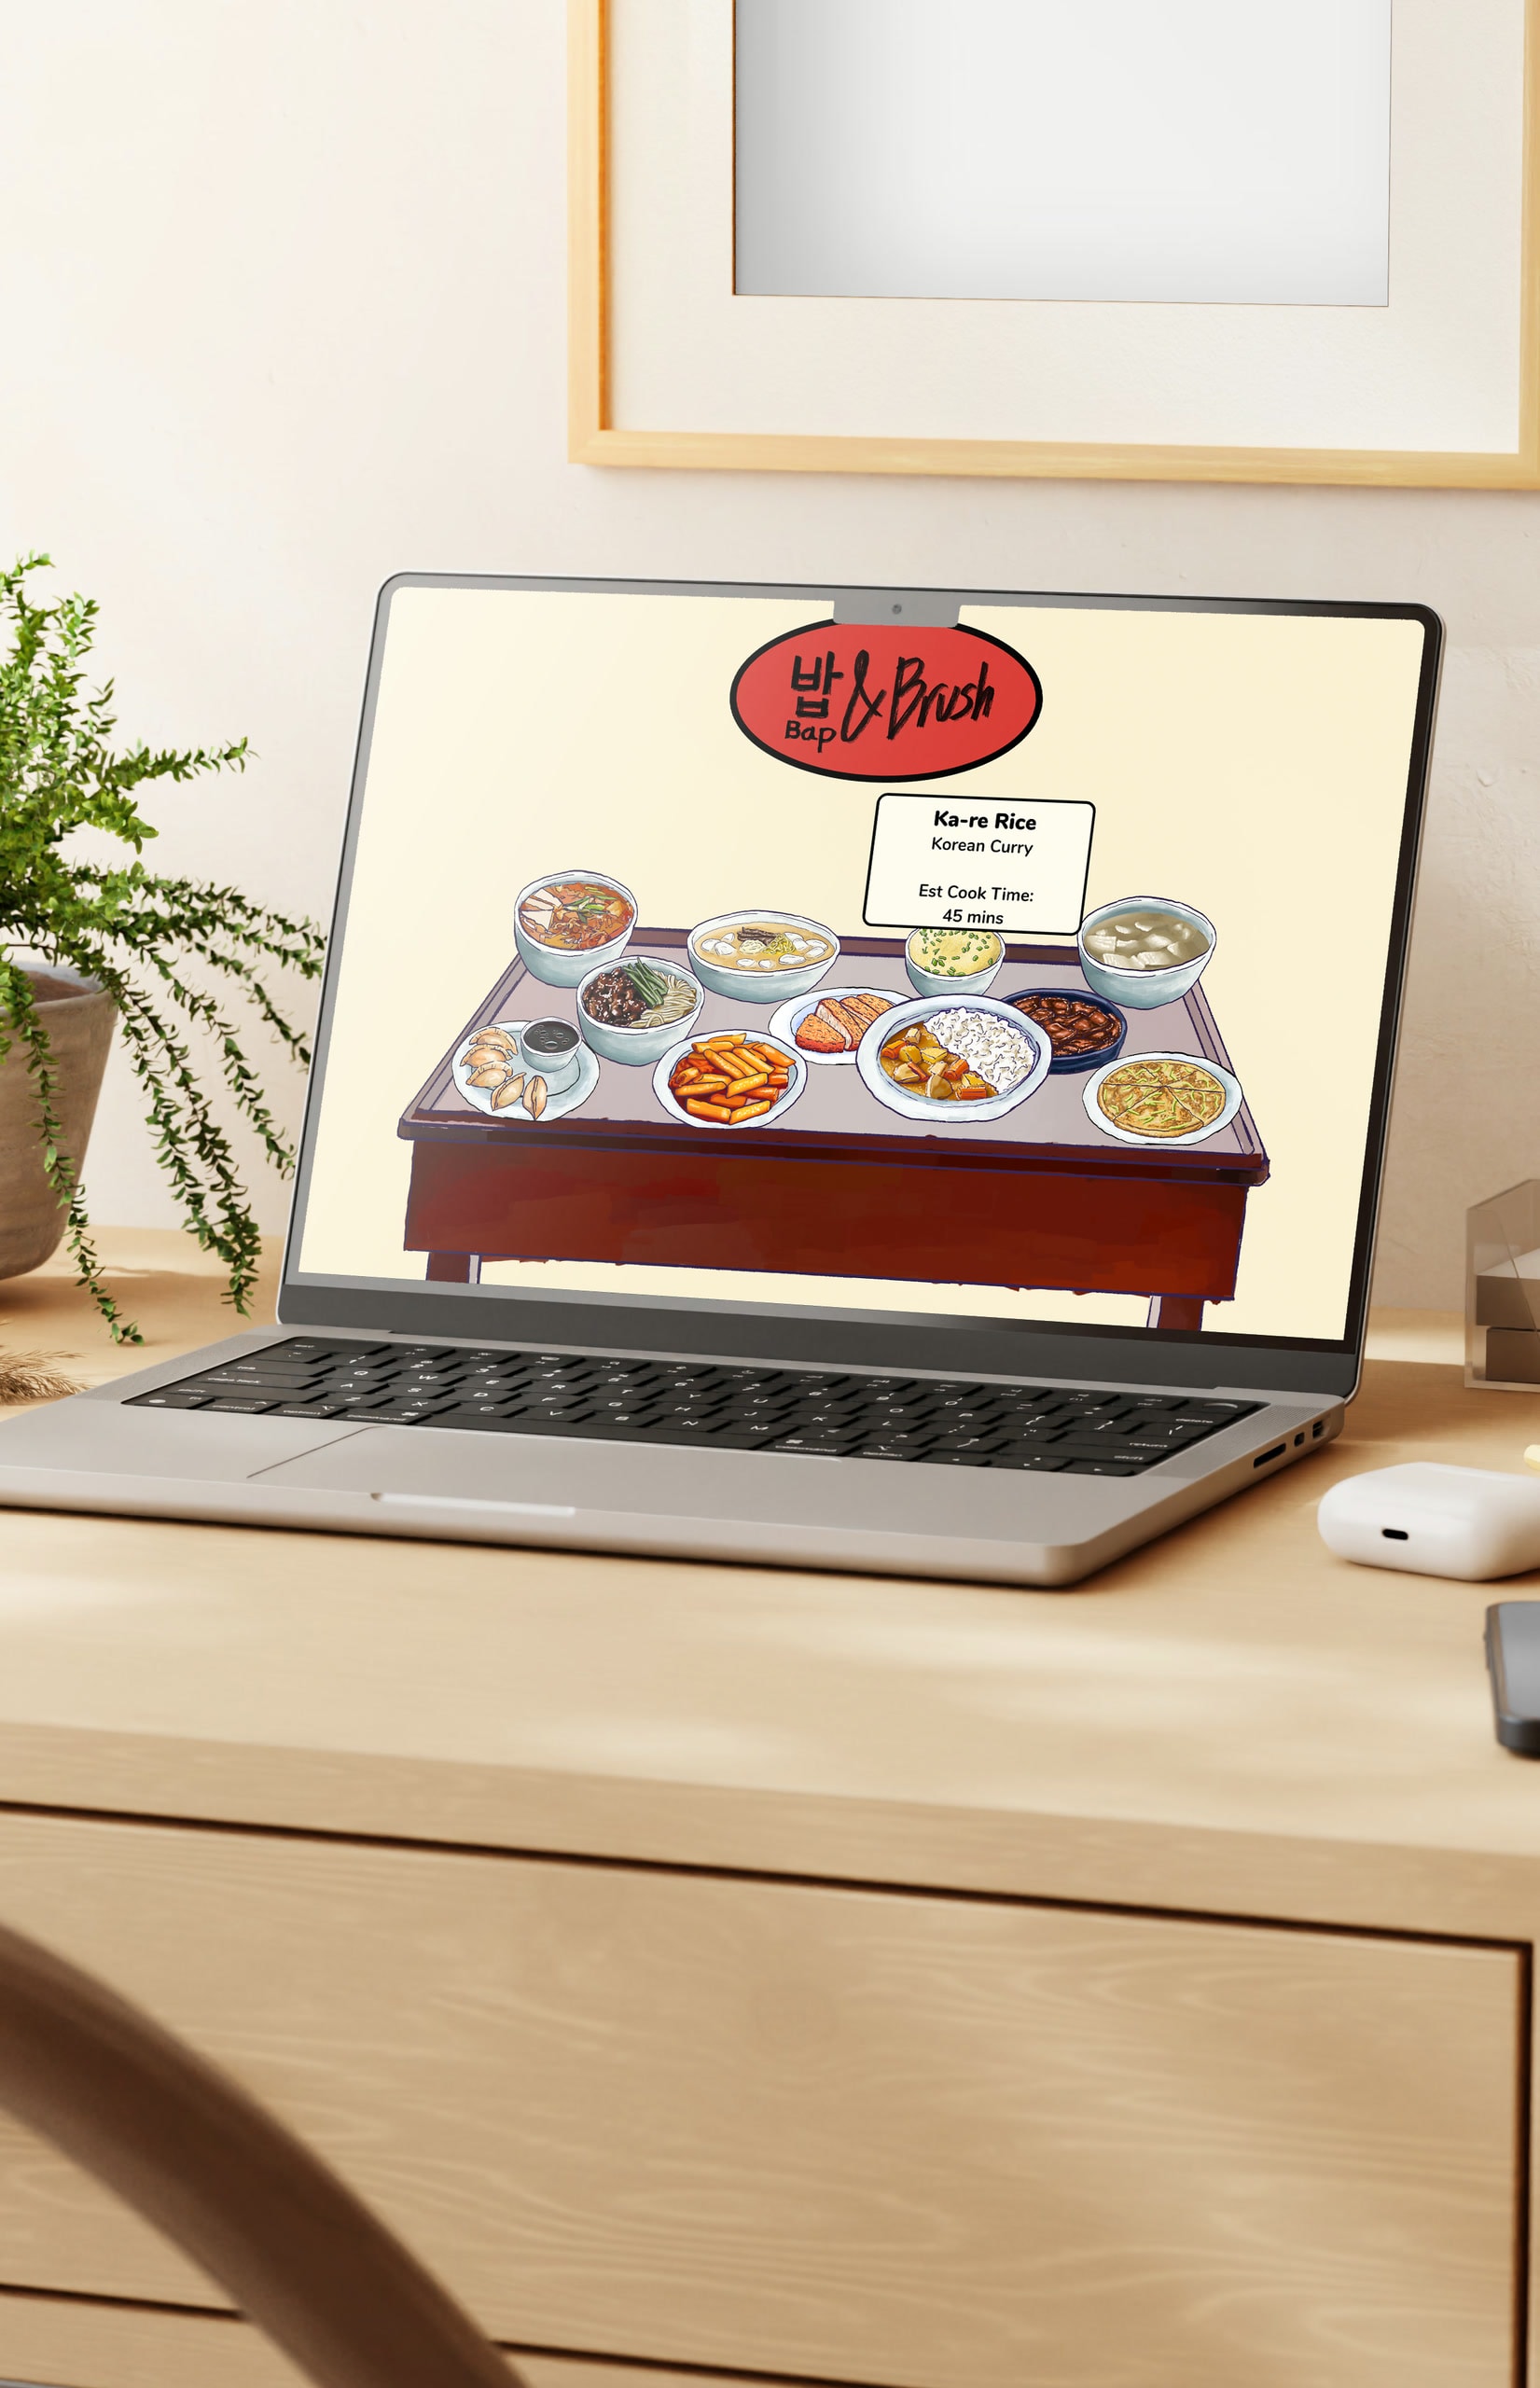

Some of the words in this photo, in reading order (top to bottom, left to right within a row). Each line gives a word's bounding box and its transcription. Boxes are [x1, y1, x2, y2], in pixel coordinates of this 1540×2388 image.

[791, 650, 843, 719] 밥
[840, 649, 887, 743] &
[886, 656, 995, 741] Brush
[784, 720, 838, 753] Bap
[934, 810, 989, 829] Ka-re
[994, 812, 1037, 831] Rice
[931, 836, 985, 853] Korean
[990, 839, 1034, 856] Curry
[918, 883, 942, 898] Est
[947, 885, 987, 900] Cook
[991, 887, 1034, 902] Time:
[942, 909, 964, 923] 45
[967, 910, 1004, 924] mins
